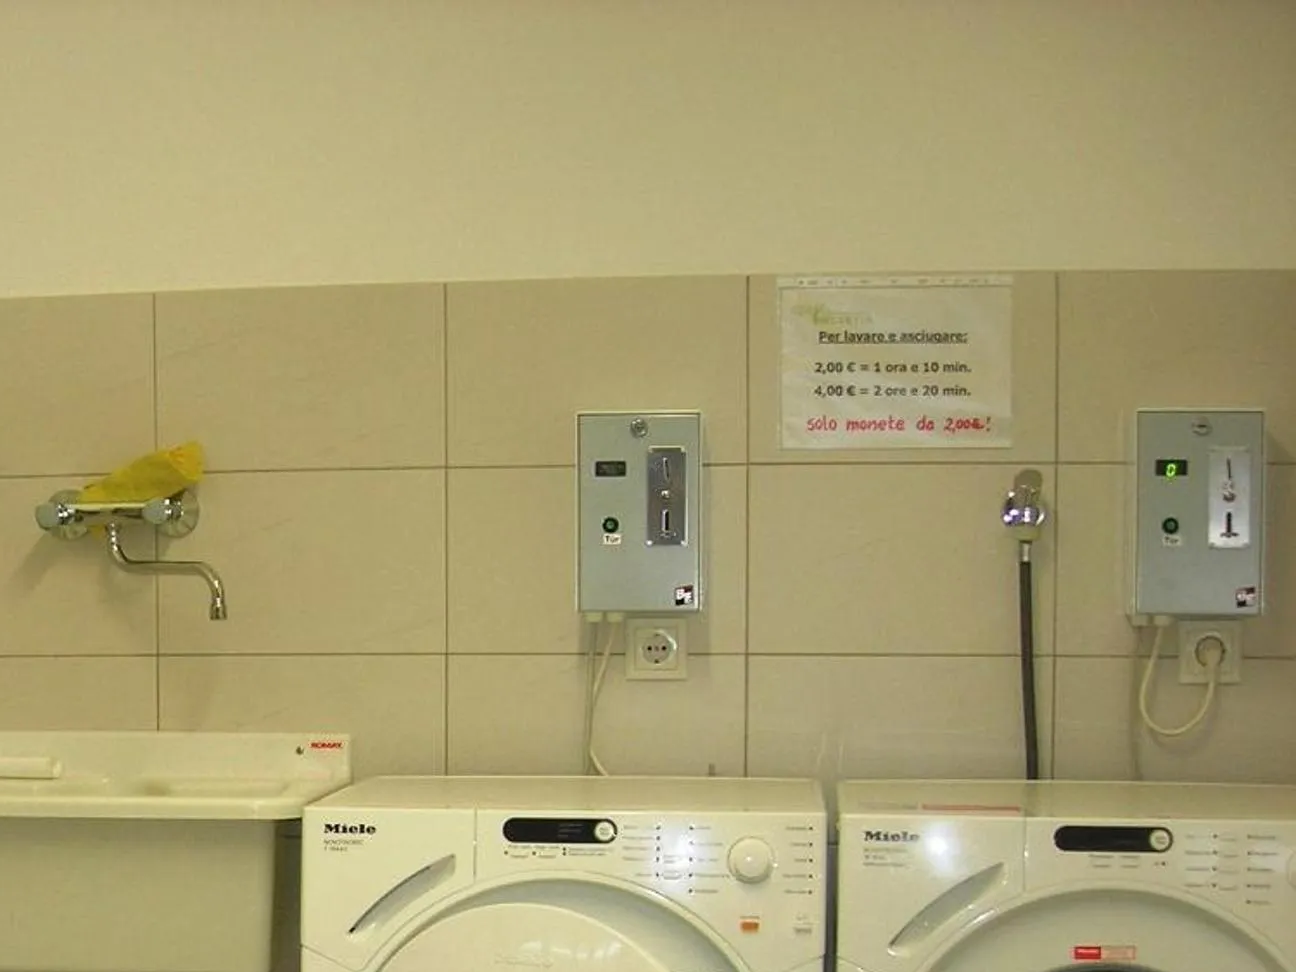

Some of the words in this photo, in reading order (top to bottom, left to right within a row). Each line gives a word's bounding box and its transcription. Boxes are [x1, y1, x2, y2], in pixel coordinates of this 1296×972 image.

[819, 330, 840, 344] Per
[843, 330, 885, 344] lavare
[887, 333, 897, 344] e
[900, 330, 968, 345] asciugare:
[814, 362, 843, 375] 2,00
[846, 362, 856, 373] €
[873, 362, 881, 373] 1
[885, 364, 907, 373] ora
[910, 364, 919, 373] e
[923, 362, 939, 373] 10
[943, 361, 972, 373] min.
[814, 385, 843, 398] 4,00
[846, 385, 856, 396] €
[873, 385, 882, 396] 2
[885, 387, 907, 396] ore
[910, 387, 919, 396] e
[922, 385, 939, 396] 20
[943, 384, 972, 396] min.
[846, 415, 905, 431] monete
[916, 415, 935, 430] da
[1166, 463, 1176, 477] 0
[323, 823, 377, 835] Miele
[863, 830, 920, 842] Miele
